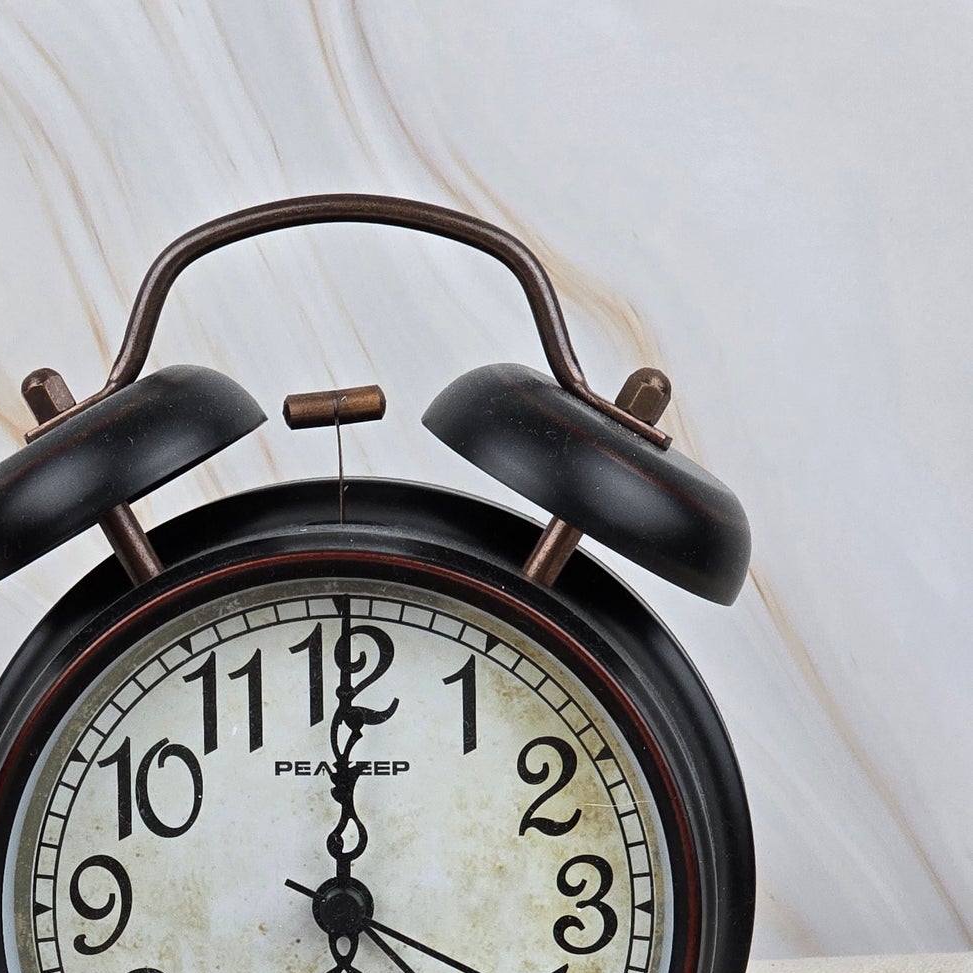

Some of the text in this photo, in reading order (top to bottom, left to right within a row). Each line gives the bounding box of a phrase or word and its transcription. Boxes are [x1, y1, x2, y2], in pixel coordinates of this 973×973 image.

[183, 647, 264, 755] 11
[288, 622, 400, 727] 12
[442, 654, 477, 756] 1
[97, 736, 203, 841] 10
[275, 761, 410, 776] PEAEEP
[517, 736, 582, 837] 2
[69, 854, 133, 956] 9
[552, 854, 618, 955] 3
